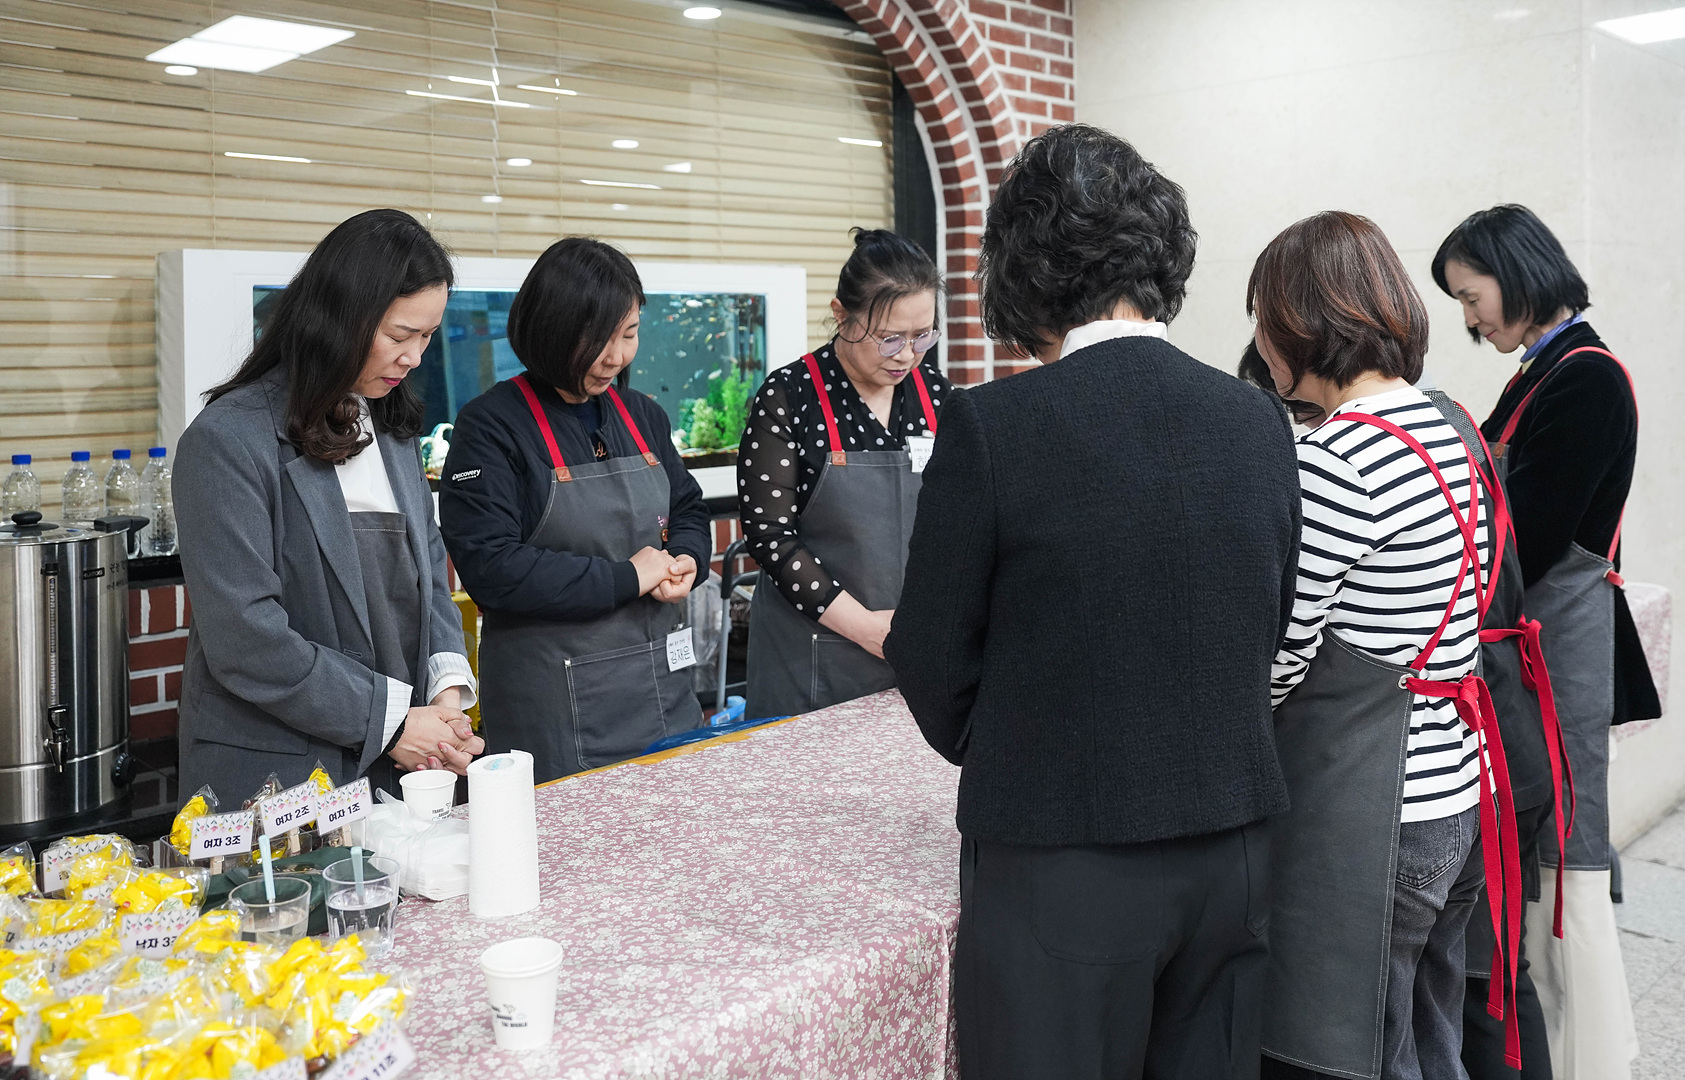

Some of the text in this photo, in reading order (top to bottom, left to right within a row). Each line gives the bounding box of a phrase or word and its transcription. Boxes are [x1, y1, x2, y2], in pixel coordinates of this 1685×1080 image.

[275, 805, 311, 827] 여자 2조
[328, 802, 361, 823] 여자 1조
[203, 834, 242, 850] 여자 3조
[373, 1052, 398, 1077] 11조
